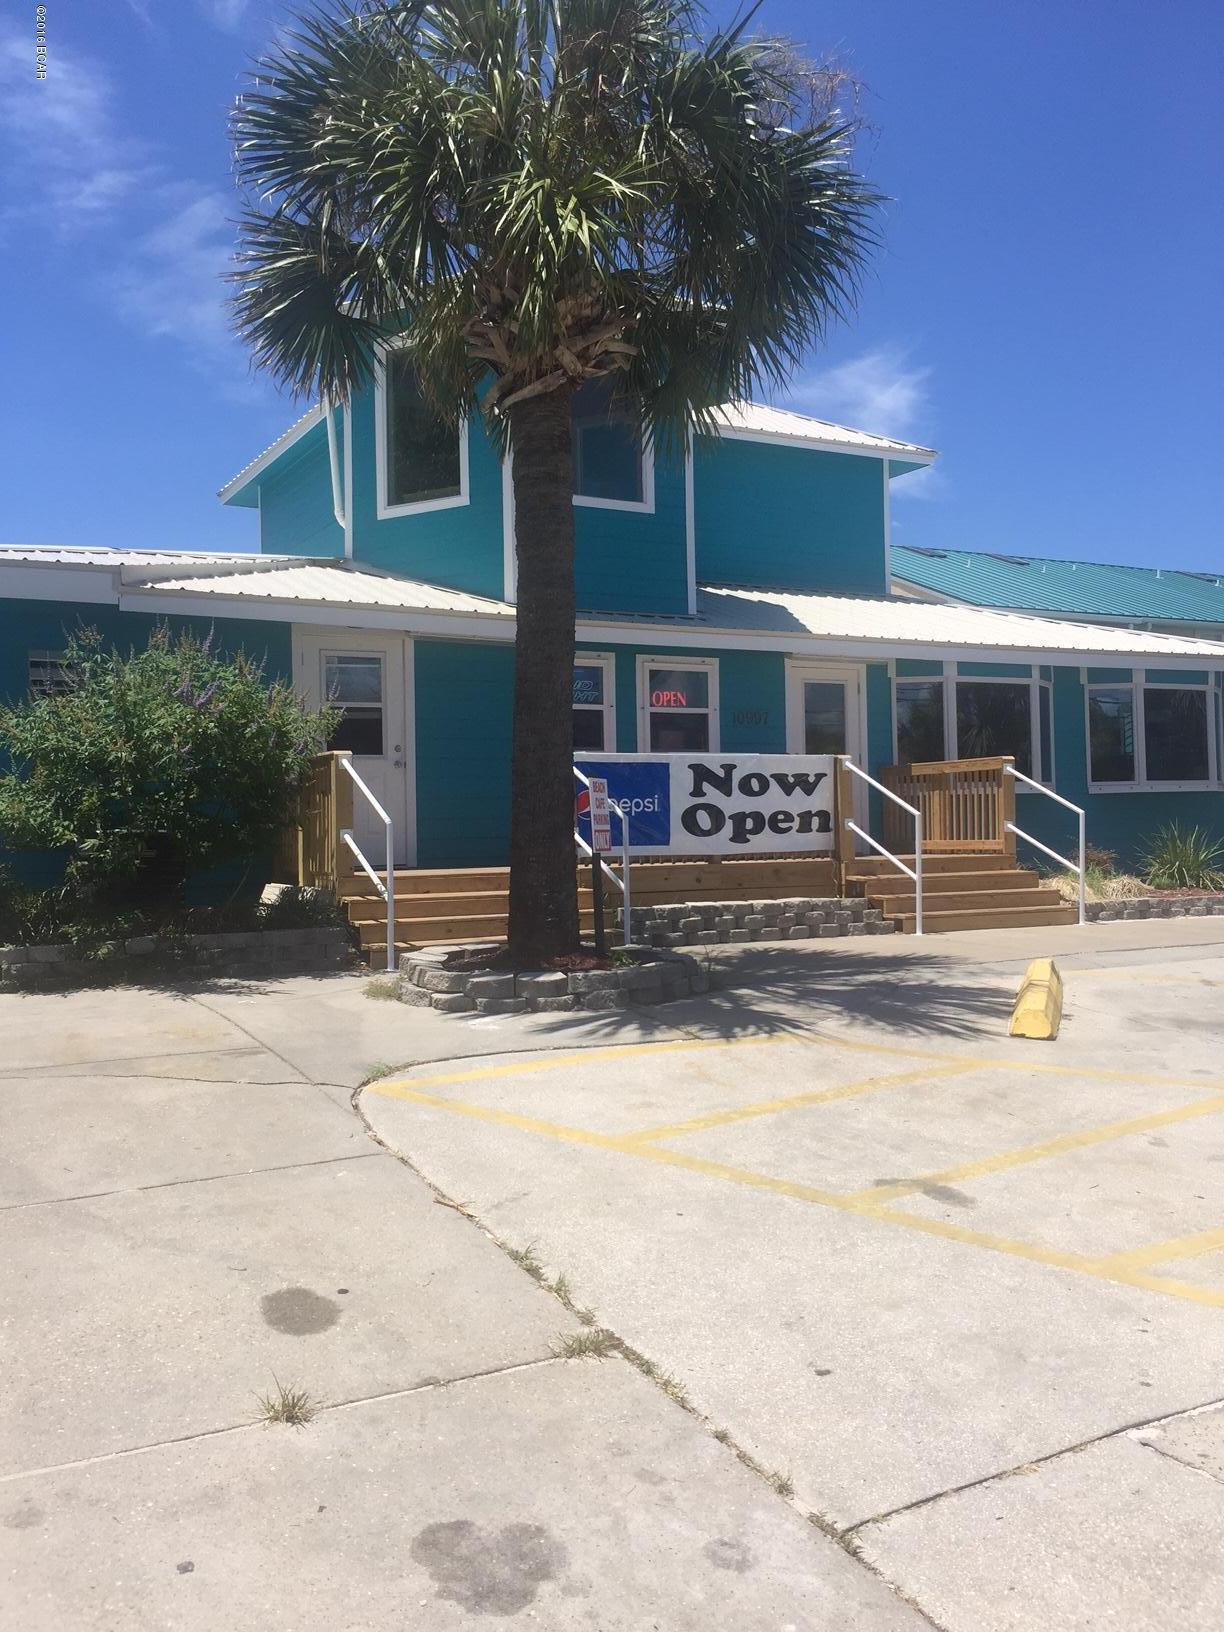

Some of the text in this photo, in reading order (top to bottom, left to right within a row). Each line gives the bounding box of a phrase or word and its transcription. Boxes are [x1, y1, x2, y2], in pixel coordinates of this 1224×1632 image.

[652, 690, 687, 707] OPEN
[687, 763, 828, 798] Now
[681, 802, 833, 844] Open
